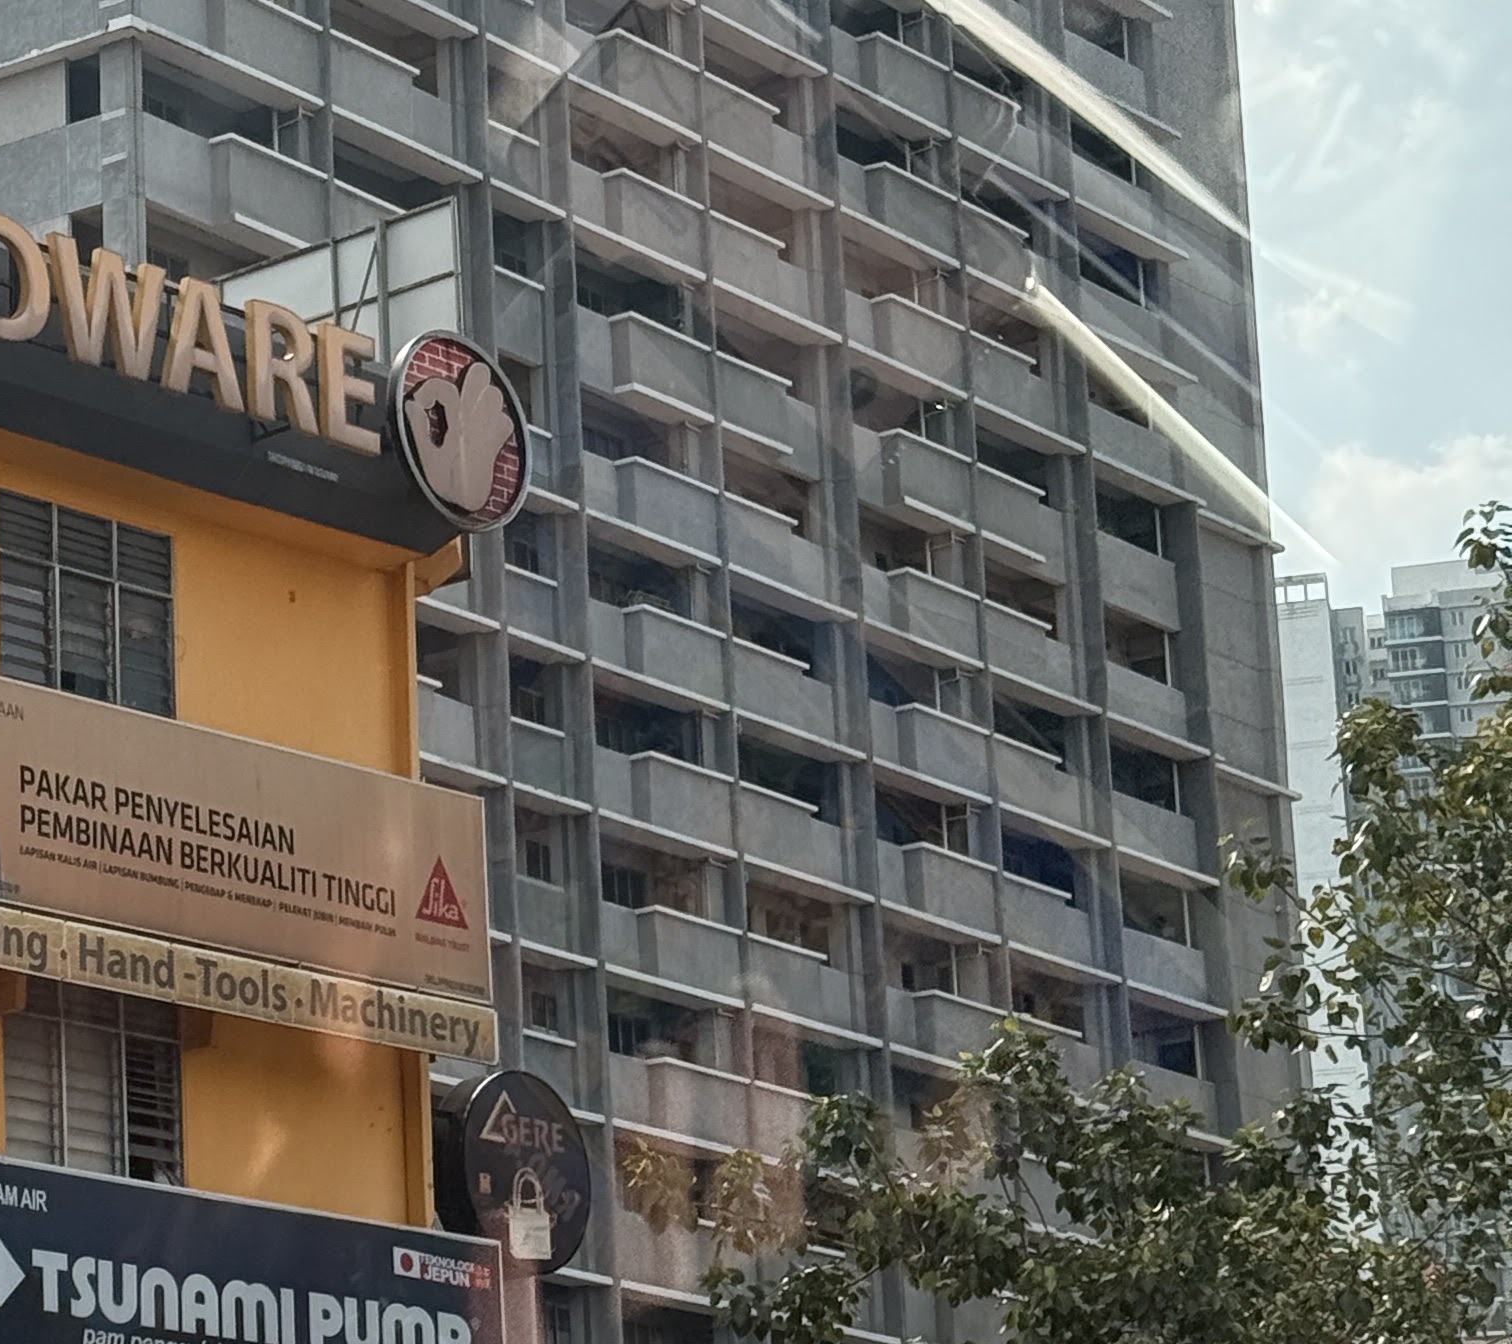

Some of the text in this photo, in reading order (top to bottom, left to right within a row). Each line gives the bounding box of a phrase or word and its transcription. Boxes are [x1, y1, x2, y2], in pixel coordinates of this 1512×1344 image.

[19, 764, 296, 856] PAKAR PENYELESAIAN
[20, 804, 397, 917] PEMBINAAN BERKUALITI TINGGI
[422, 877, 460, 921] Sika
[79, 931, 175, 991] Hand
[310, 977, 481, 1055] Machinery
[19, 1185, 49, 1213] AIR
[422, 1264, 470, 1288] JEPUN
